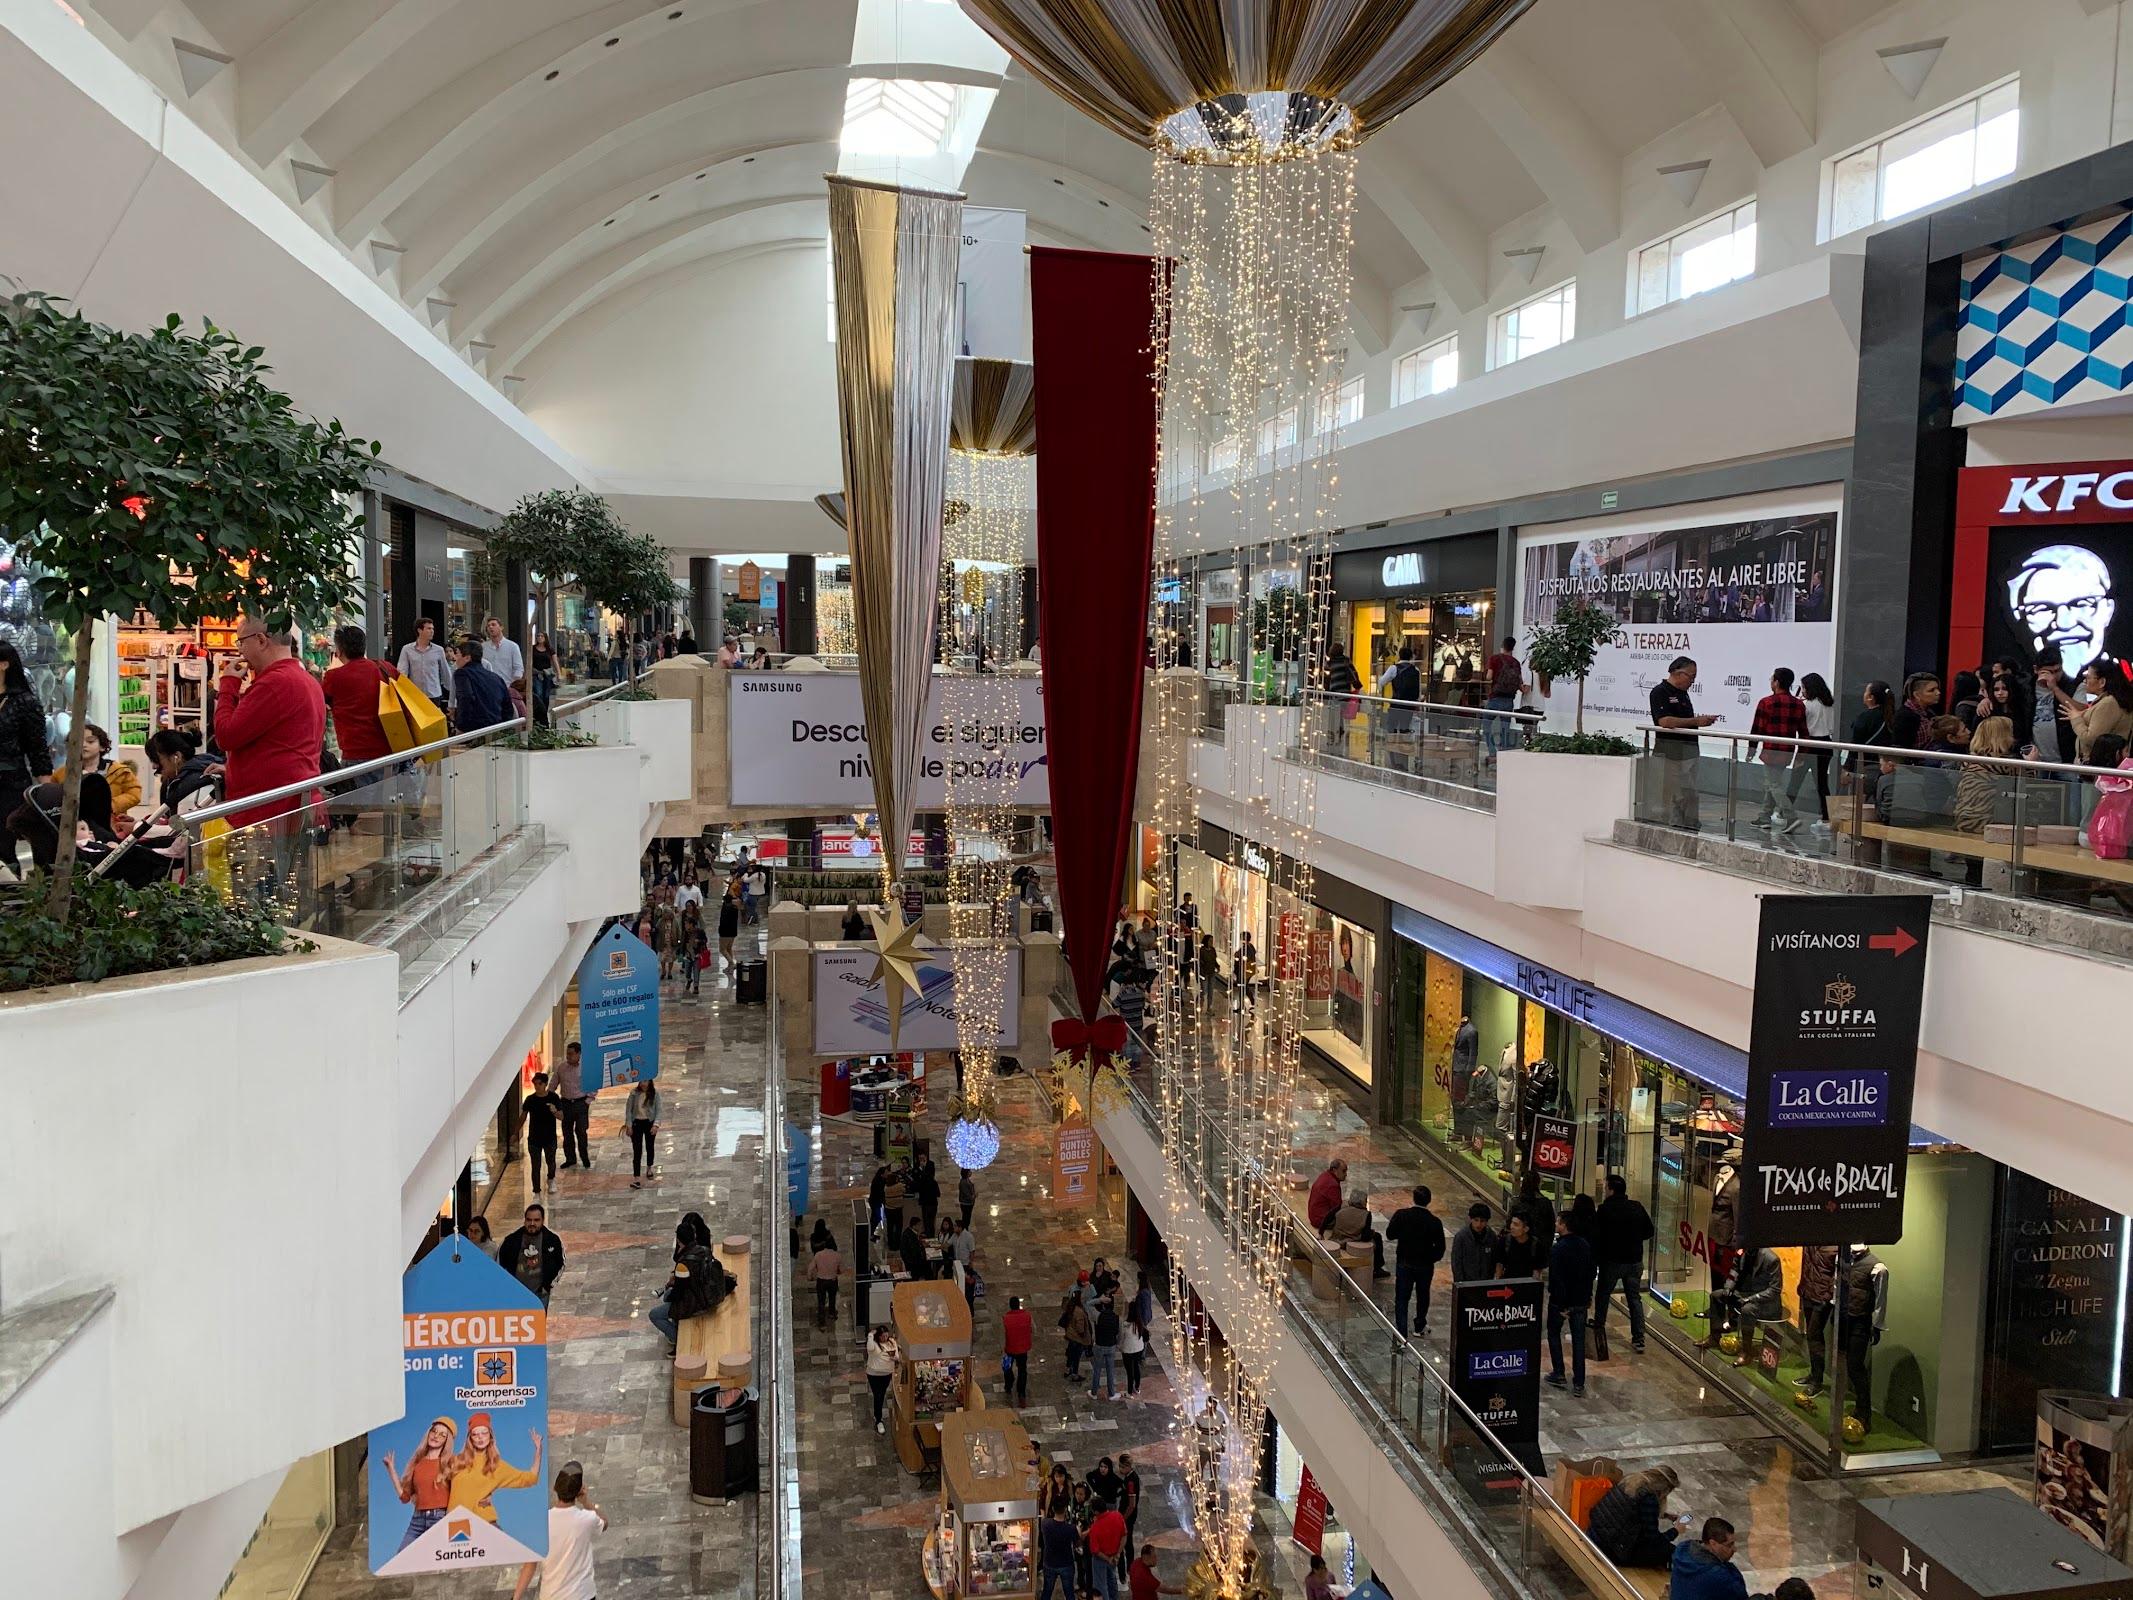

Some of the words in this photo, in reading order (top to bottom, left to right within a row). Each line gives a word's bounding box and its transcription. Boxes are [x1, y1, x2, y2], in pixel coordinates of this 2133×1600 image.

[1999, 471, 2133, 513] KFC
[1540, 576, 1585, 596] DISFRUTA
[1587, 574, 1608, 594] LOS
[1611, 568, 1704, 592] RESTAURANTES
[1707, 567, 1724, 588] AL
[1728, 564, 1761, 587] AIRE
[1766, 561, 1807, 585] LIBRE
[1615, 634, 1629, 649] LA
[1633, 633, 1690, 650] TERRAZA
[743, 682, 802, 693] SAMSUNG
[792, 720, 870, 742] Descu
[1313, 934, 1328, 951] RE
[1771, 930, 1860, 952] ¡VISÍTANOS!
[1313, 955, 1329, 971] BA
[626, 984, 638, 994] CSF
[1517, 963, 1557, 1005] HIGH
[1562, 982, 1597, 1023] LIFE
[601, 1000, 611, 1008] de
[612, 996, 628, 1006] 600
[628, 992, 655, 1004] regalos
[619, 1004, 646, 1015] compras
[1799, 1010, 1877, 1025] STUFFA
[1434, 1063, 1451, 1094] SA
[1779, 1080, 1811, 1107] La
[1815, 1078, 1878, 1106] Calle
[1778, 1112, 1804, 1121] COCINA
[1804, 1111, 1840, 1120] MEXICANA
[1841, 1111, 1847, 1119] Y
[1847, 1111, 1877, 1119] CANTINA
[1544, 1122, 1569, 1136] SALE
[1060, 1139, 1092, 1152] PUNTOS
[1060, 1149, 1091, 1161] DOBLES
[1538, 1144, 1568, 1165] 50%
[1758, 1164, 1817, 1204] TEXAS
[1817, 1168, 1832, 1191] de
[1772, 1204, 1821, 1212] CHURRASCARIA
[1840, 1202, 1881, 1210] STEAKHOUSE
[2020, 1217, 2111, 1236] CANALI
[2014, 1243, 2115, 1263] CALDERONI
[2047, 1274, 2091, 1290] Zegna
[2071, 1298, 2103, 1315] LIFE
[1465, 1307, 1495, 1327] TEXAS
[1496, 1308, 1503, 1320] de
[404, 1314, 536, 1347] IÉRCOLES
[404, 1356, 432, 1371] son
[438, 1353, 463, 1369] de:
[1474, 1356, 1490, 1369] La
[1492, 1354, 1523, 1369] Calle
[456, 1386, 535, 1400] Recompensas
[467, 1399, 524, 1408] CentroSantaFe
[435, 1547, 485, 1561] SantaFe
